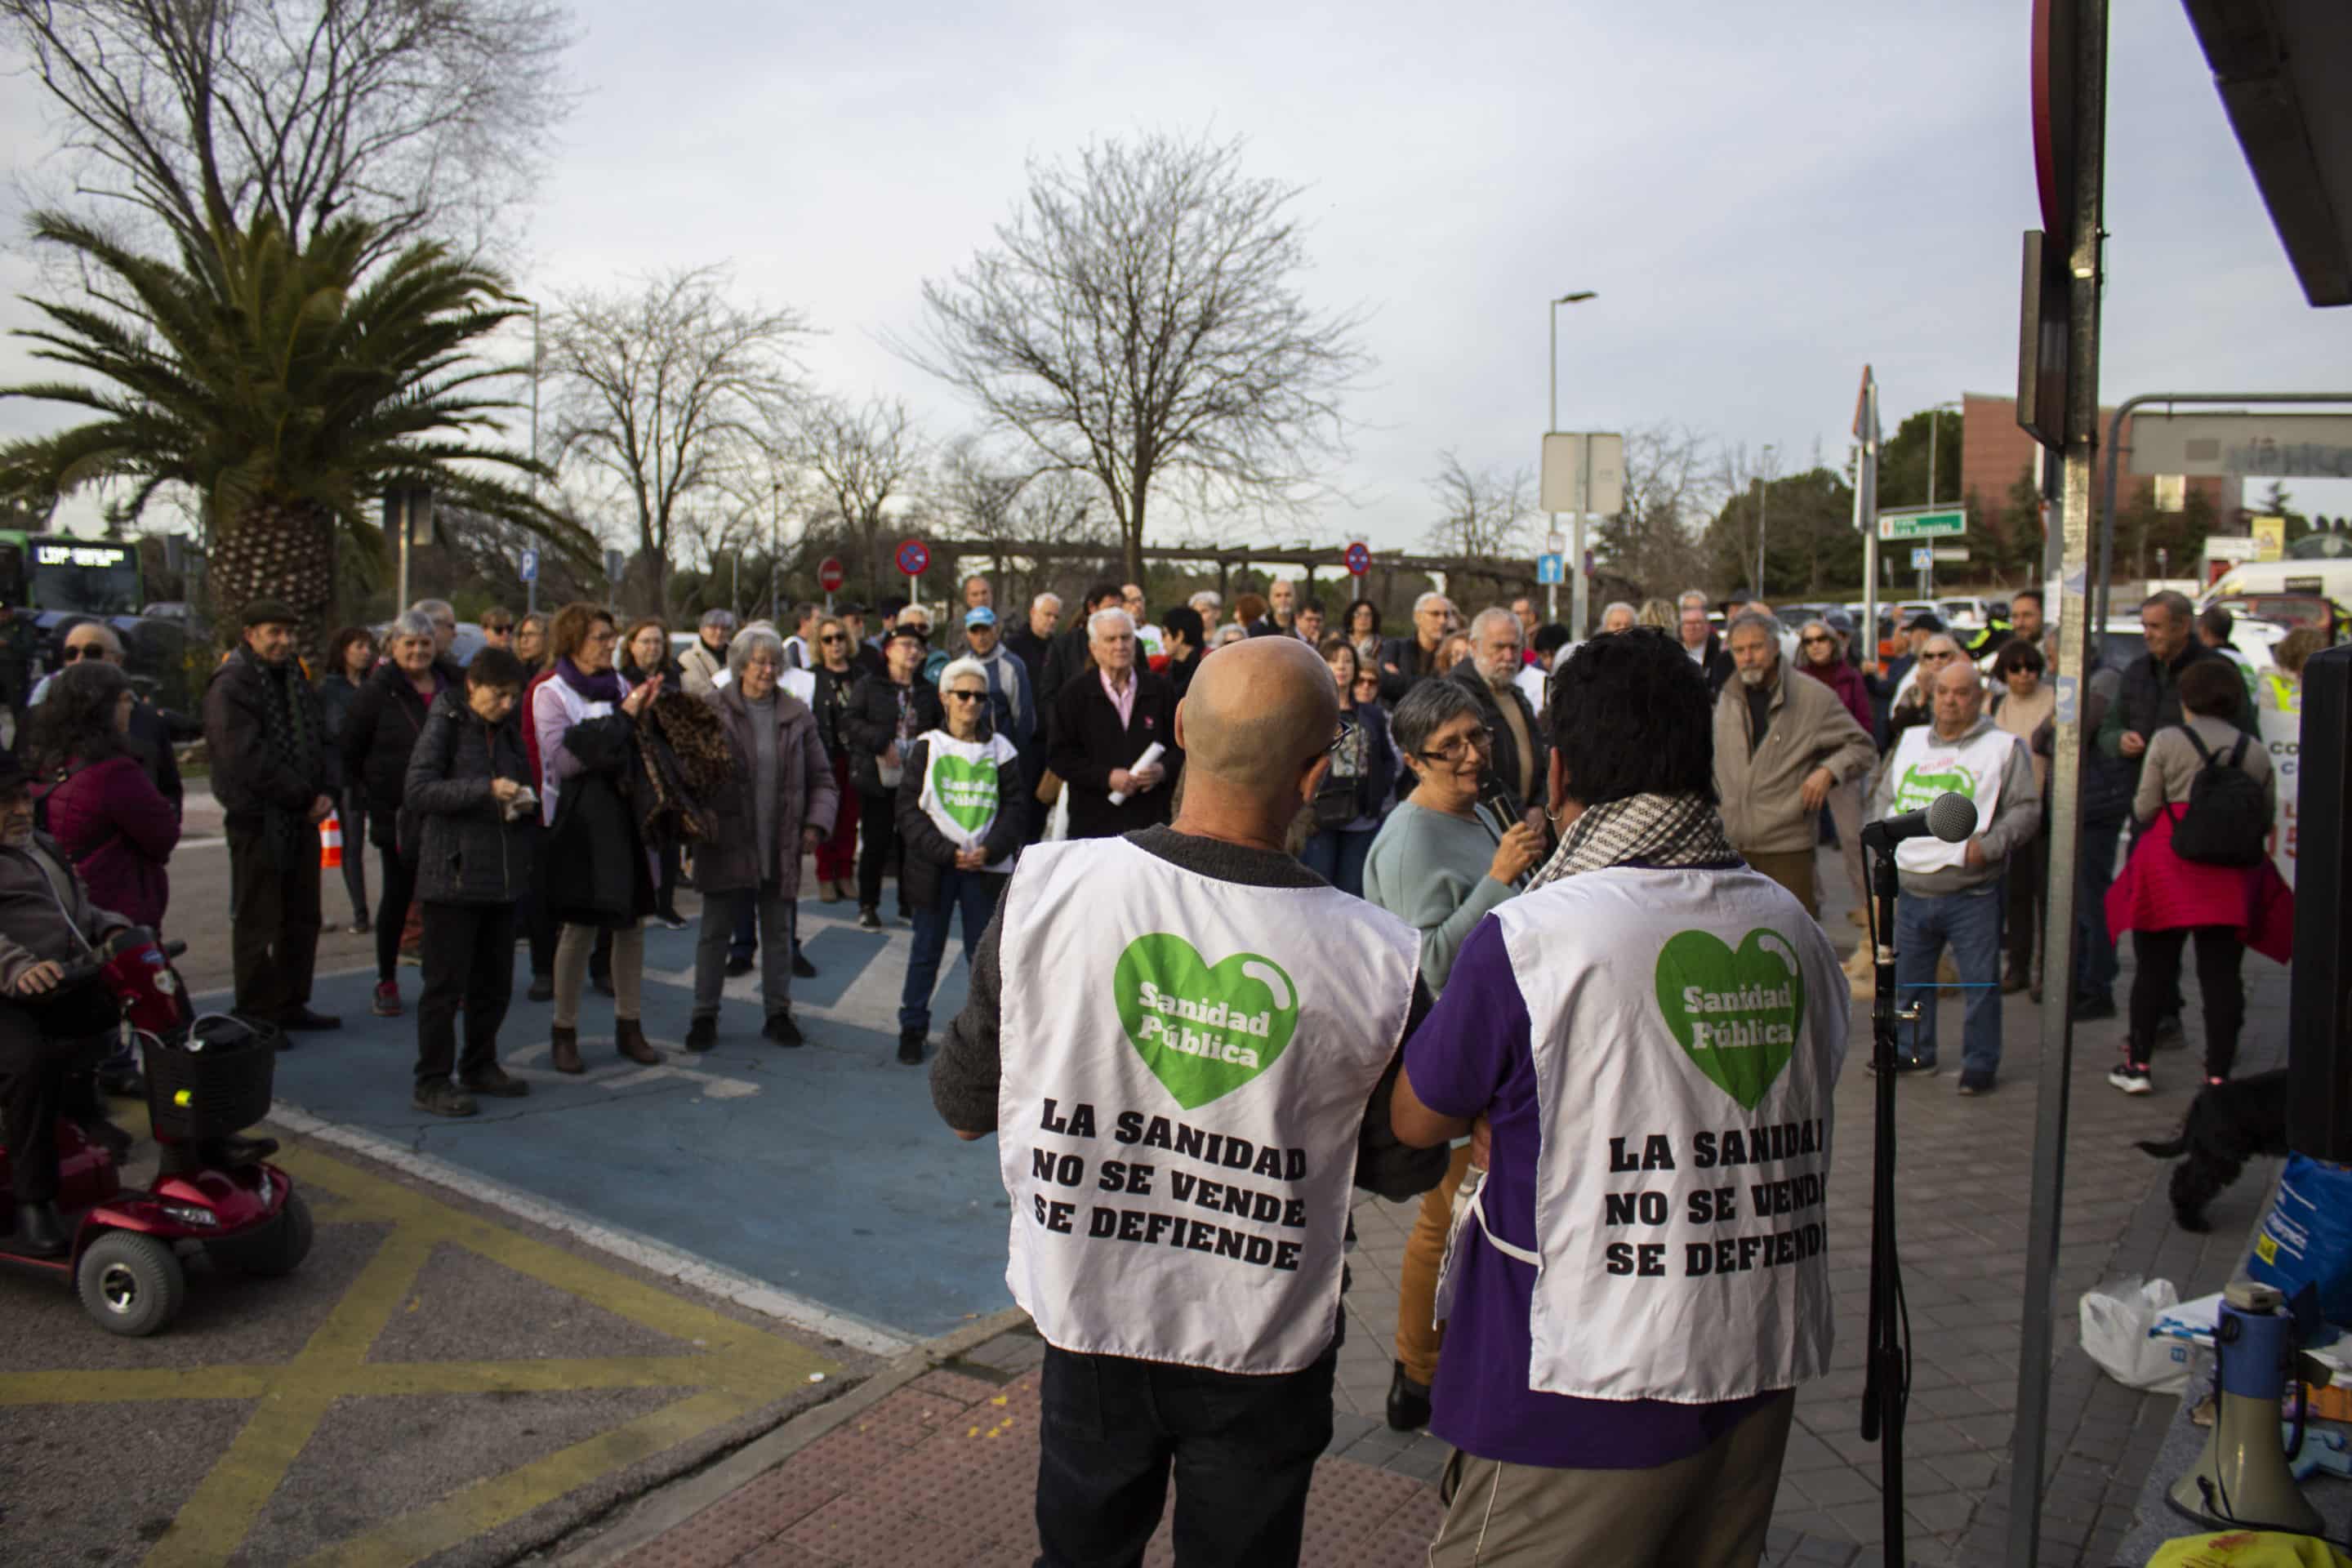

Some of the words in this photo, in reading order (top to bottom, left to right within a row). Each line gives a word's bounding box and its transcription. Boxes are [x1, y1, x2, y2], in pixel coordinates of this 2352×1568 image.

[1138, 982, 1270, 1037] Sanidad
[1684, 981, 1791, 1013] Sanidad
[1138, 1014, 1258, 1069] Pública
[1692, 1019, 1793, 1049] Pública
[1040, 1098, 1096, 1138] LA
[1115, 1111, 1307, 1181] SANIDAD
[1610, 1134, 1675, 1173] LA
[1032, 1147, 1084, 1187] NO
[1098, 1160, 1155, 1196] SE
[1171, 1169, 1307, 1227] VENDE
[1606, 1191, 1668, 1225] NO
[1687, 1187, 1735, 1224] SE
[1035, 1193, 1076, 1234] SE
[1089, 1206, 1303, 1271] DEFIENDE
[1606, 1242, 1665, 1276] SE
